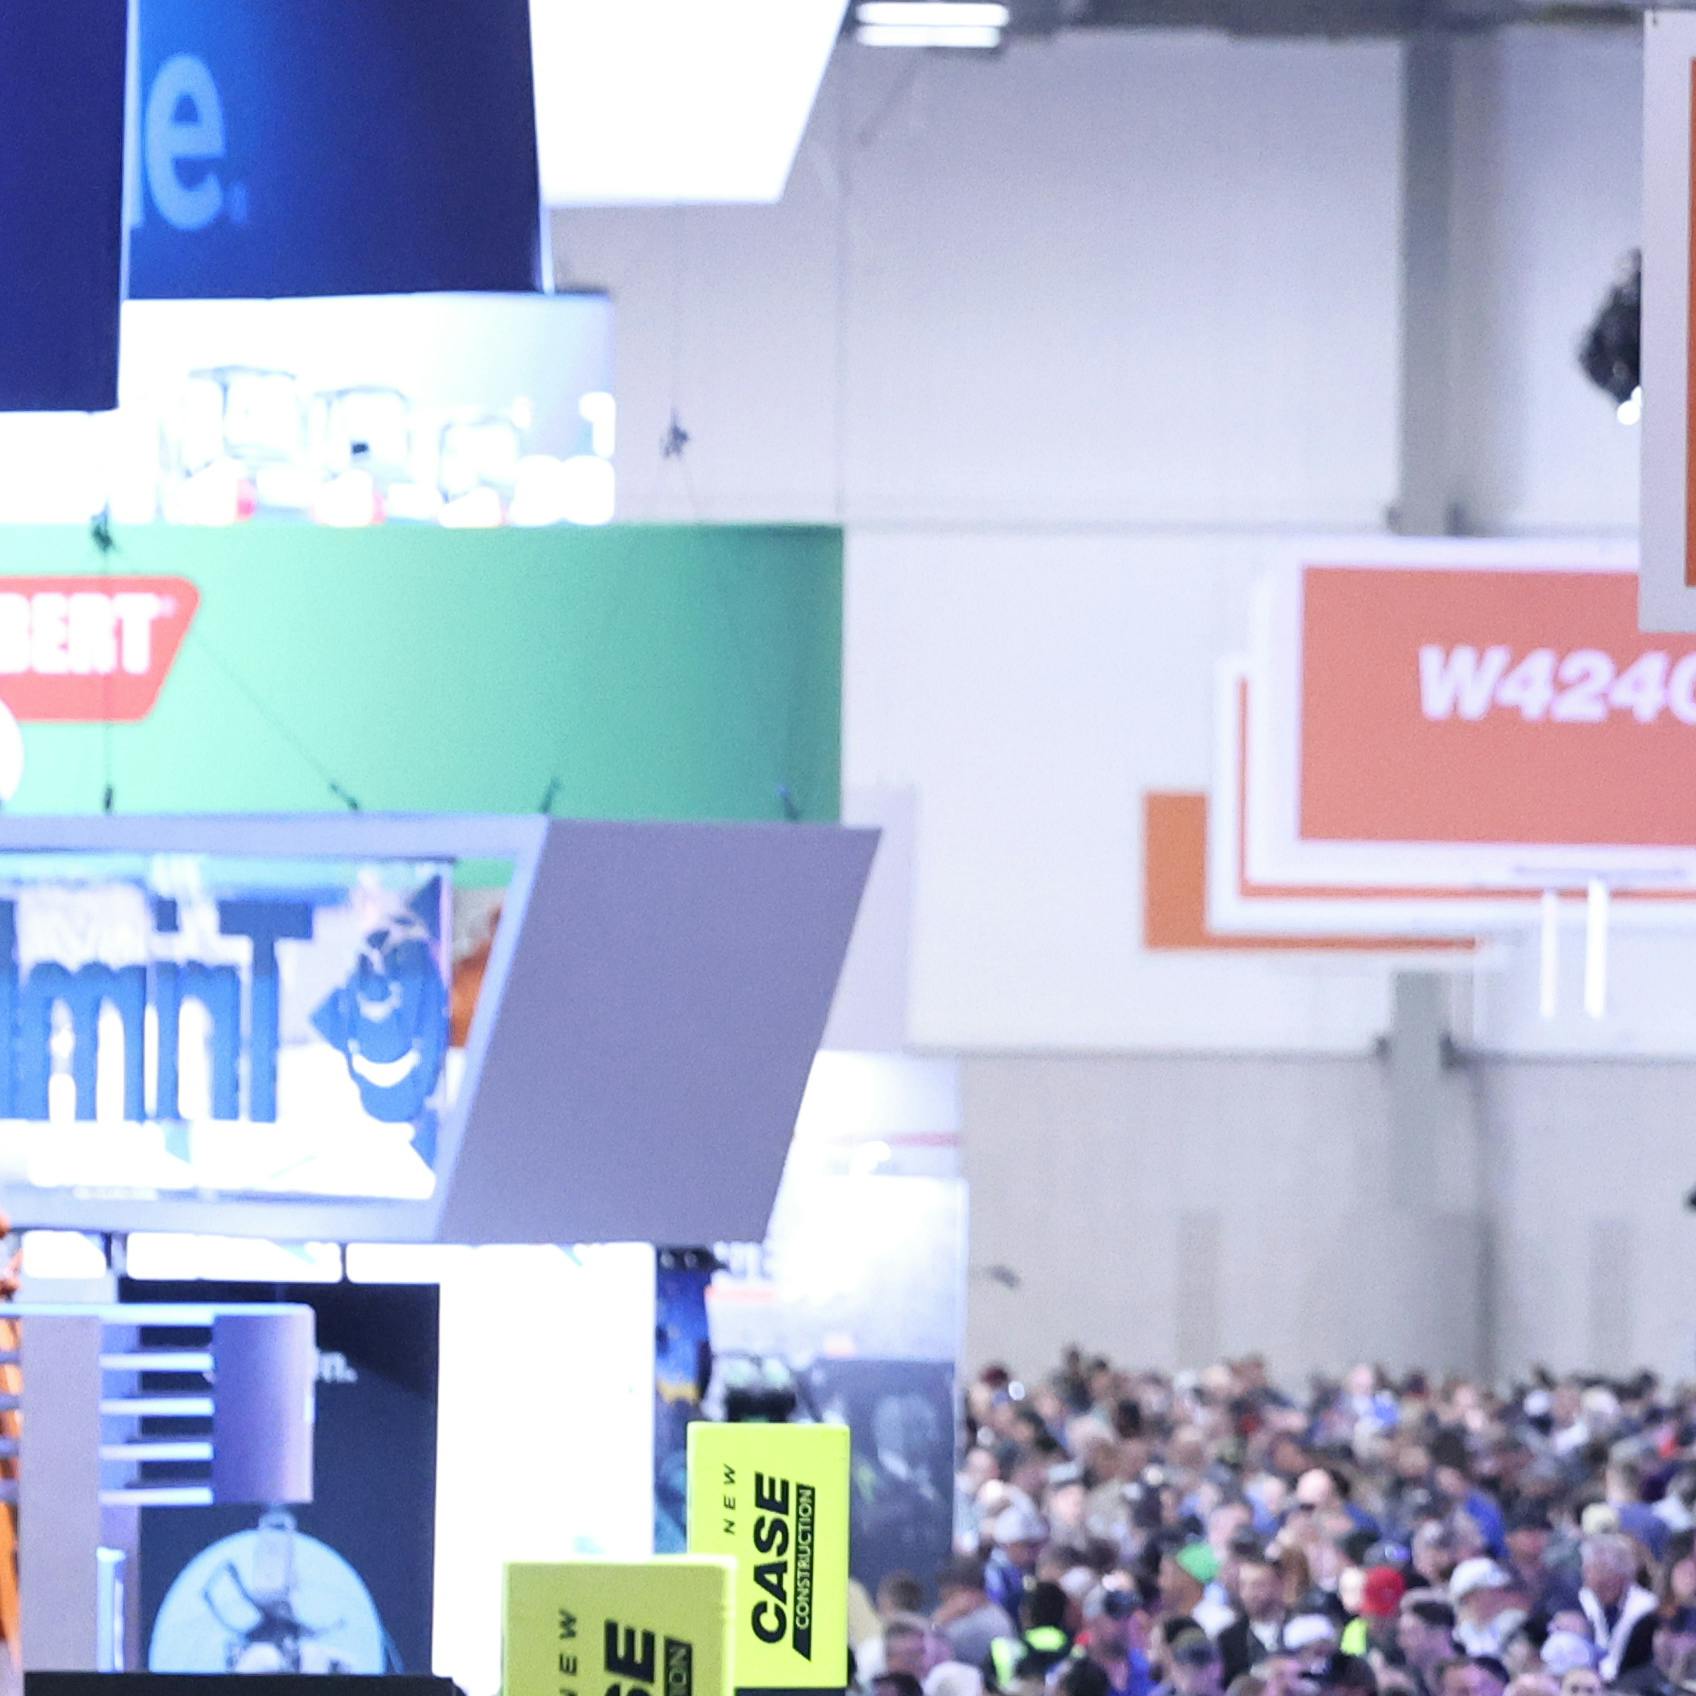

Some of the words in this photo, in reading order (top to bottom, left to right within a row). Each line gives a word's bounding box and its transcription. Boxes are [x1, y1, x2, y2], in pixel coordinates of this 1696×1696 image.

[723, 1464, 736, 1535] NEW
[751, 1471, 789, 1644] CASE
[795, 1488, 812, 1630] CONSTRUCTION
